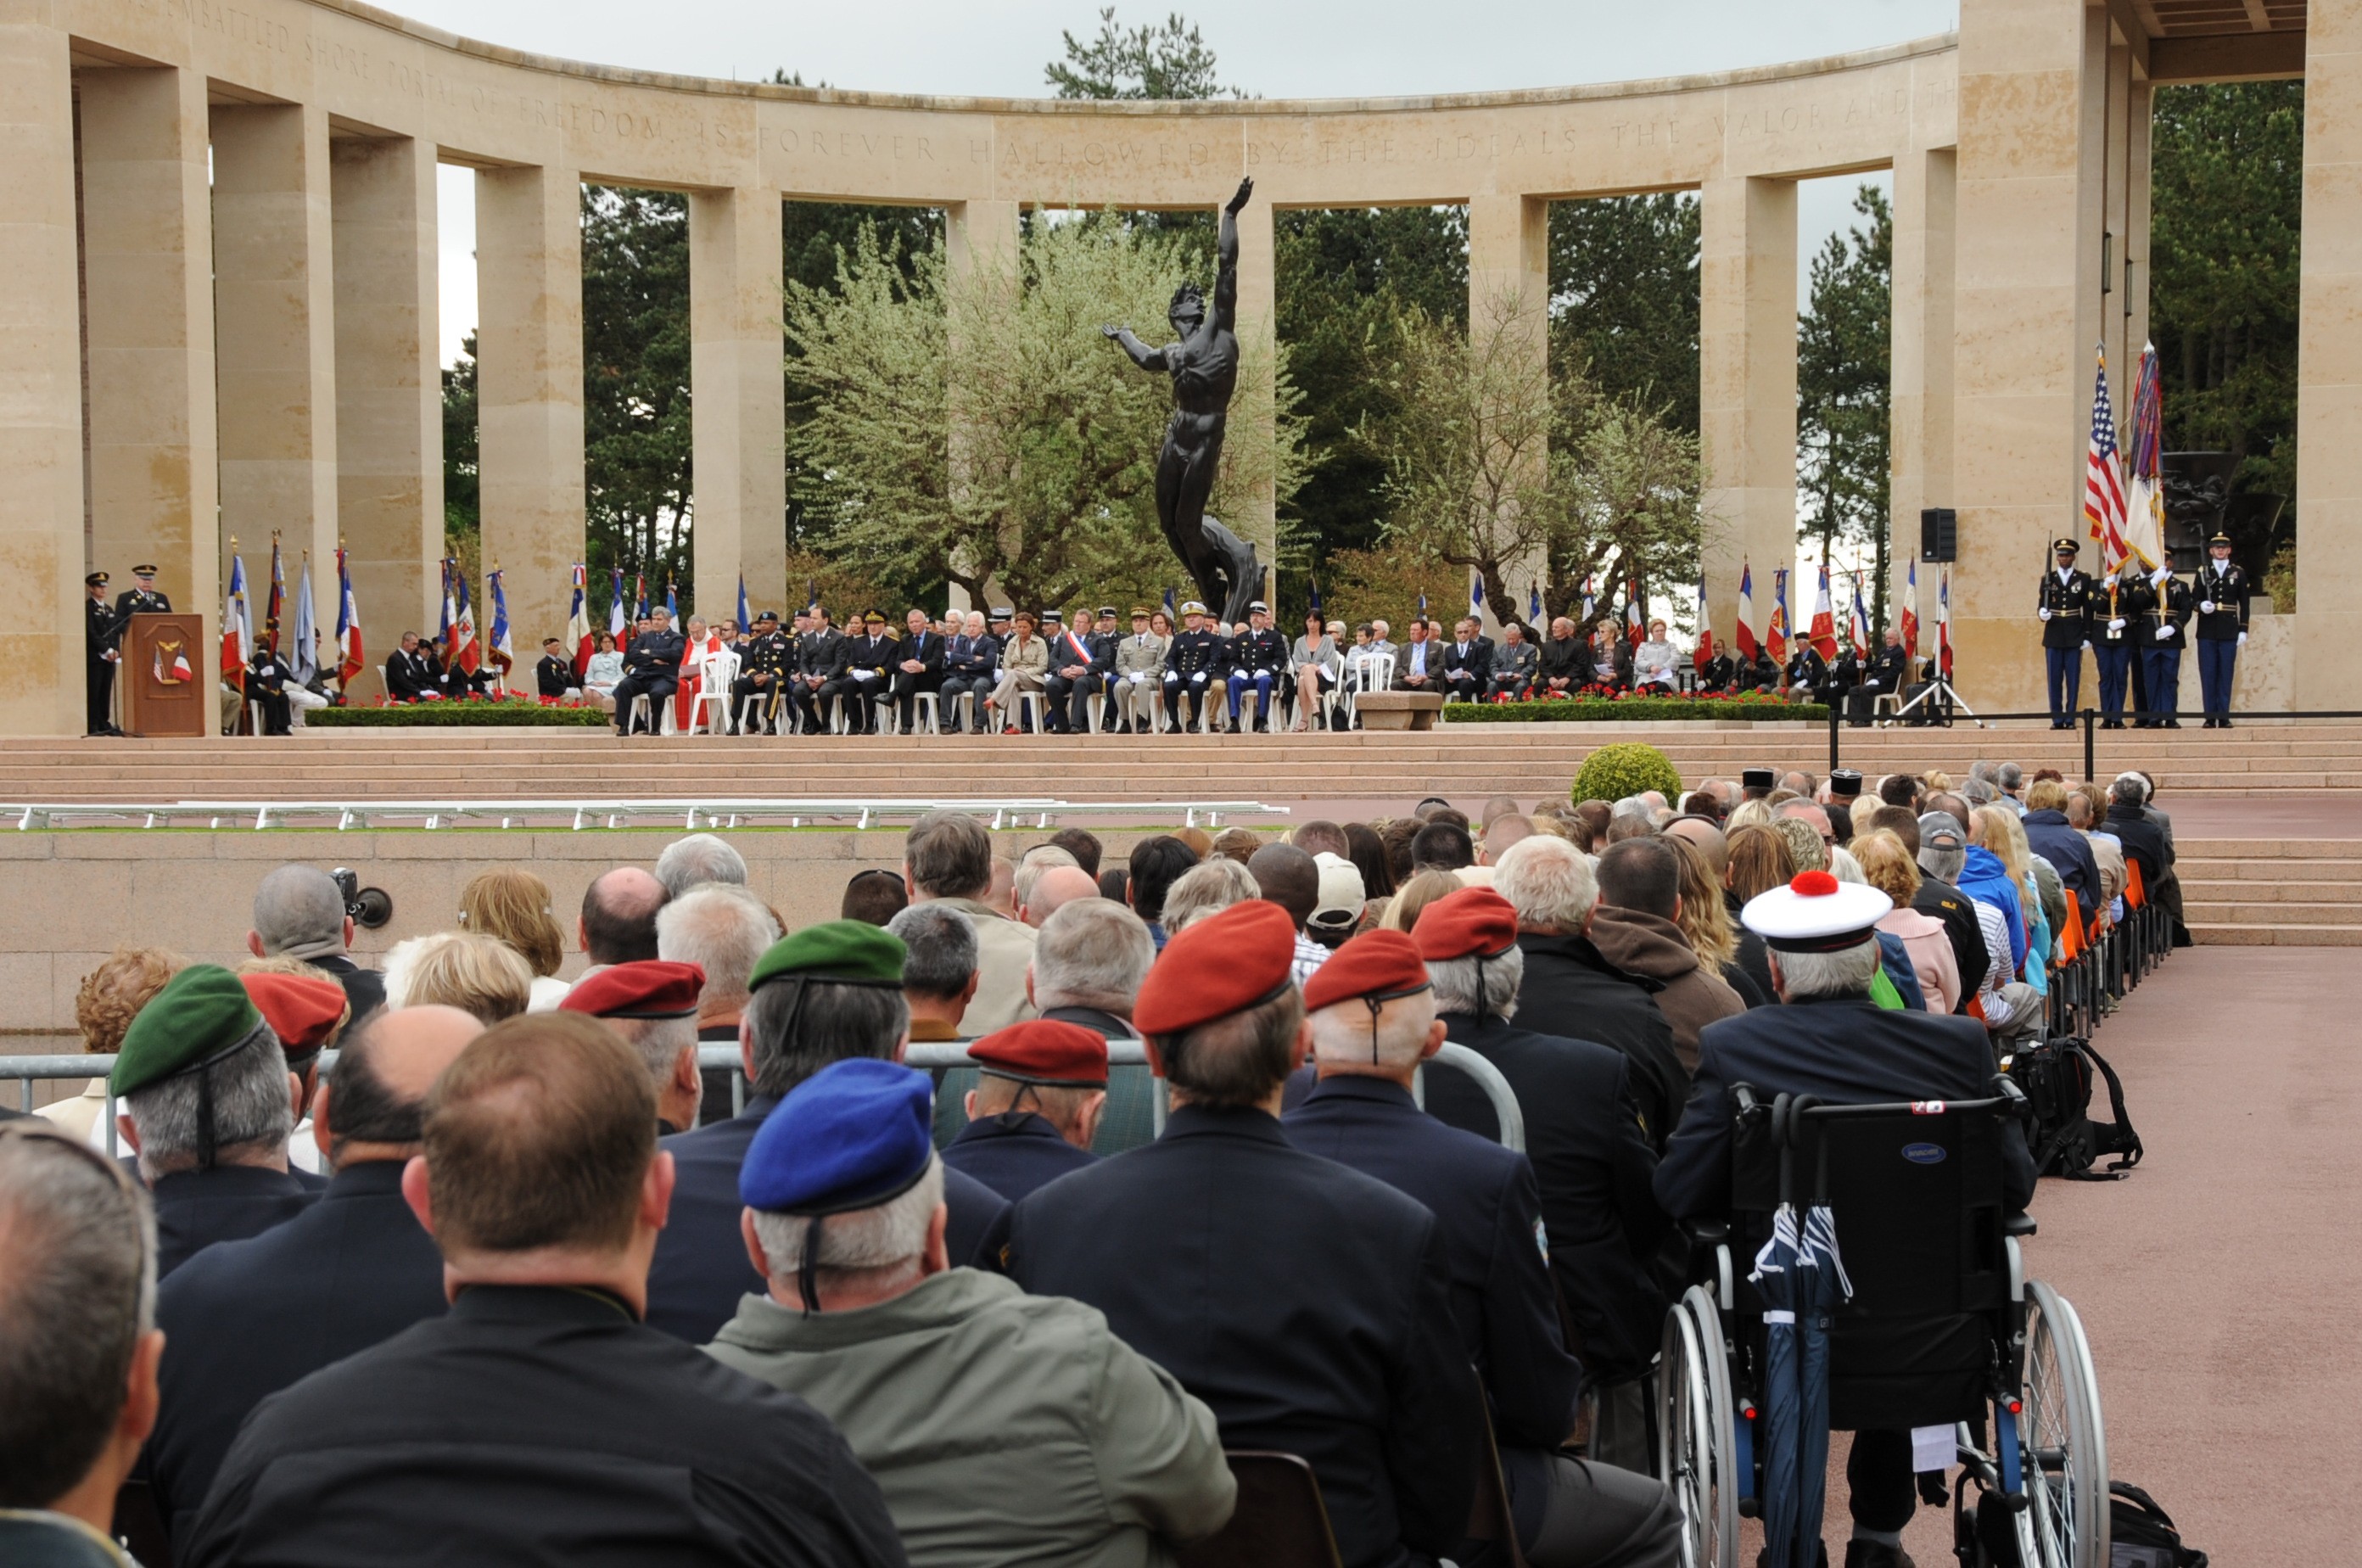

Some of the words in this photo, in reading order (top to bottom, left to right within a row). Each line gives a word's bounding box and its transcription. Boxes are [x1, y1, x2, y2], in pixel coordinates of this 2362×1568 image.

[388, 60, 456, 107] PORTAL
[471, 87, 499, 115] OF
[699, 121, 728, 148] IS
[758, 126, 935, 161] FOREVER
[970, 138, 1209, 166] HALLOWED
[1246, 142, 1288, 165] BY
[1319, 139, 1394, 163] THE
[1433, 129, 1576, 160] IDEALS
[1611, 120, 1680, 149] THE
[1714, 103, 1825, 137] VALOR
[1845, 89, 1908, 124] AND
[1927, 77, 1956, 109] TH
